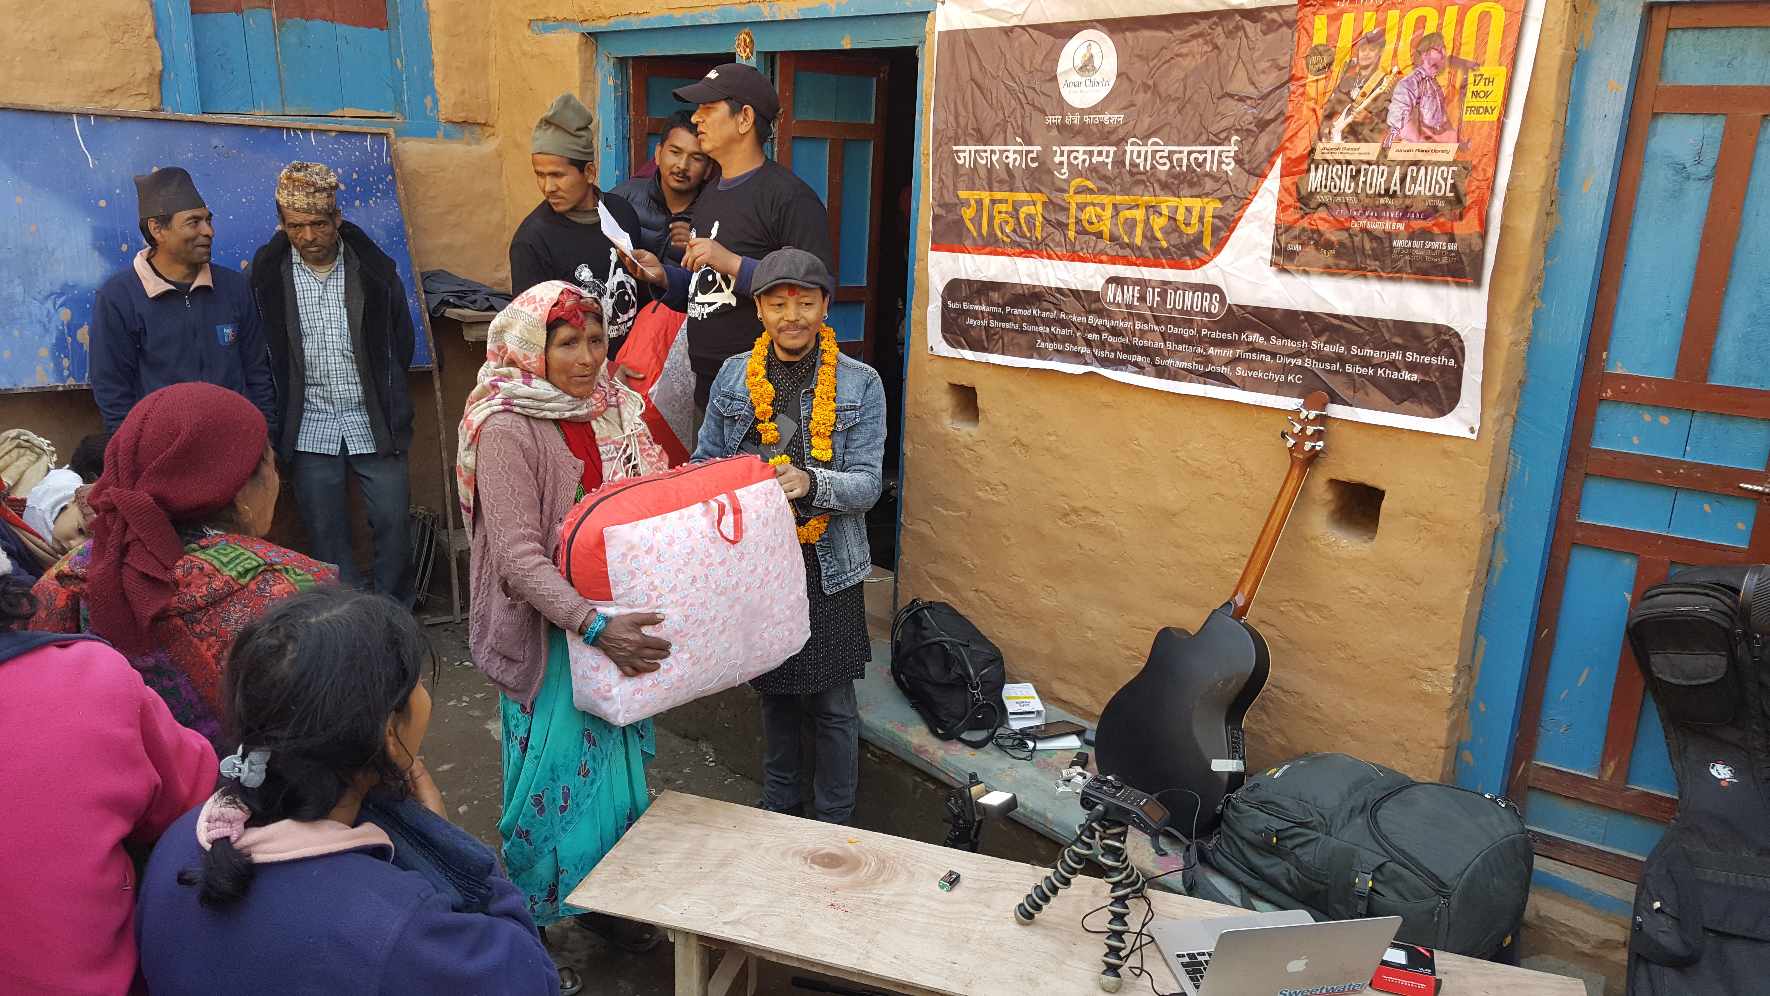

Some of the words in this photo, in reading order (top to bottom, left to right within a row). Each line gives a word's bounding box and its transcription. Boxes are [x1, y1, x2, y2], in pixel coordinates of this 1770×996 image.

[1471, 90, 1494, 99] NOV
[1473, 74, 1494, 86] 17TH
[1044, 114, 1063, 125] अमर
[1465, 105, 1497, 116] FRIDAY
[952, 137, 1042, 169] जाजरकोट
[1053, 145, 1117, 179] भुकम्प
[1125, 136, 1241, 175] पिडितलाई
[1308, 163, 1356, 193] MUSIC
[1358, 165, 1388, 194] FOR
[1390, 165, 1401, 196] A
[1405, 166, 1458, 197] CAUSE
[957, 190, 1049, 243] राहत
[1064, 178, 1223, 251] बितरण
[1392, 239, 1412, 248] KNOCK
[1412, 240, 1425, 249] OUT
[1425, 241, 1447, 250] SPORTS
[1106, 283, 1141, 306] NAME
[1146, 287, 1161, 308] OF
[1166, 289, 1220, 314] DONORS
[989, 320, 1021, 331] Shrestha,
[1050, 324, 1075, 336] Khatri,
[1132, 337, 1164, 349] Roshan
[1166, 341, 1206, 355] Bhattarai,
[1207, 346, 1236, 358] Amrit
[1236, 349, 1274, 363] Timsina,
[1276, 354, 1302, 367] Divya
[1304, 358, 1342, 373] Bhusal,
[1345, 363, 1375, 376] Bibek
[1377, 367, 1421, 384] Khadka,
[1005, 306, 1032, 316] Pramod
[1135, 321, 1165, 333] Bishwo
[1167, 324, 1199, 337] Dangol,
[1201, 328, 1239, 341] Prabesh
[1241, 331, 1267, 345] Kafle,
[1269, 335, 1308, 349] Santosh
[1310, 340, 1348, 355] Sitaula,
[1350, 345, 1402, 361] Sumanjali
[1405, 351, 1458, 369] Shrestha,
[1154, 357, 1204, 371] Sudhamshu
[1206, 364, 1233, 376] Joshi,
[1235, 366, 1285, 383] Suvekchya
[1287, 373, 1303, 384] KC
